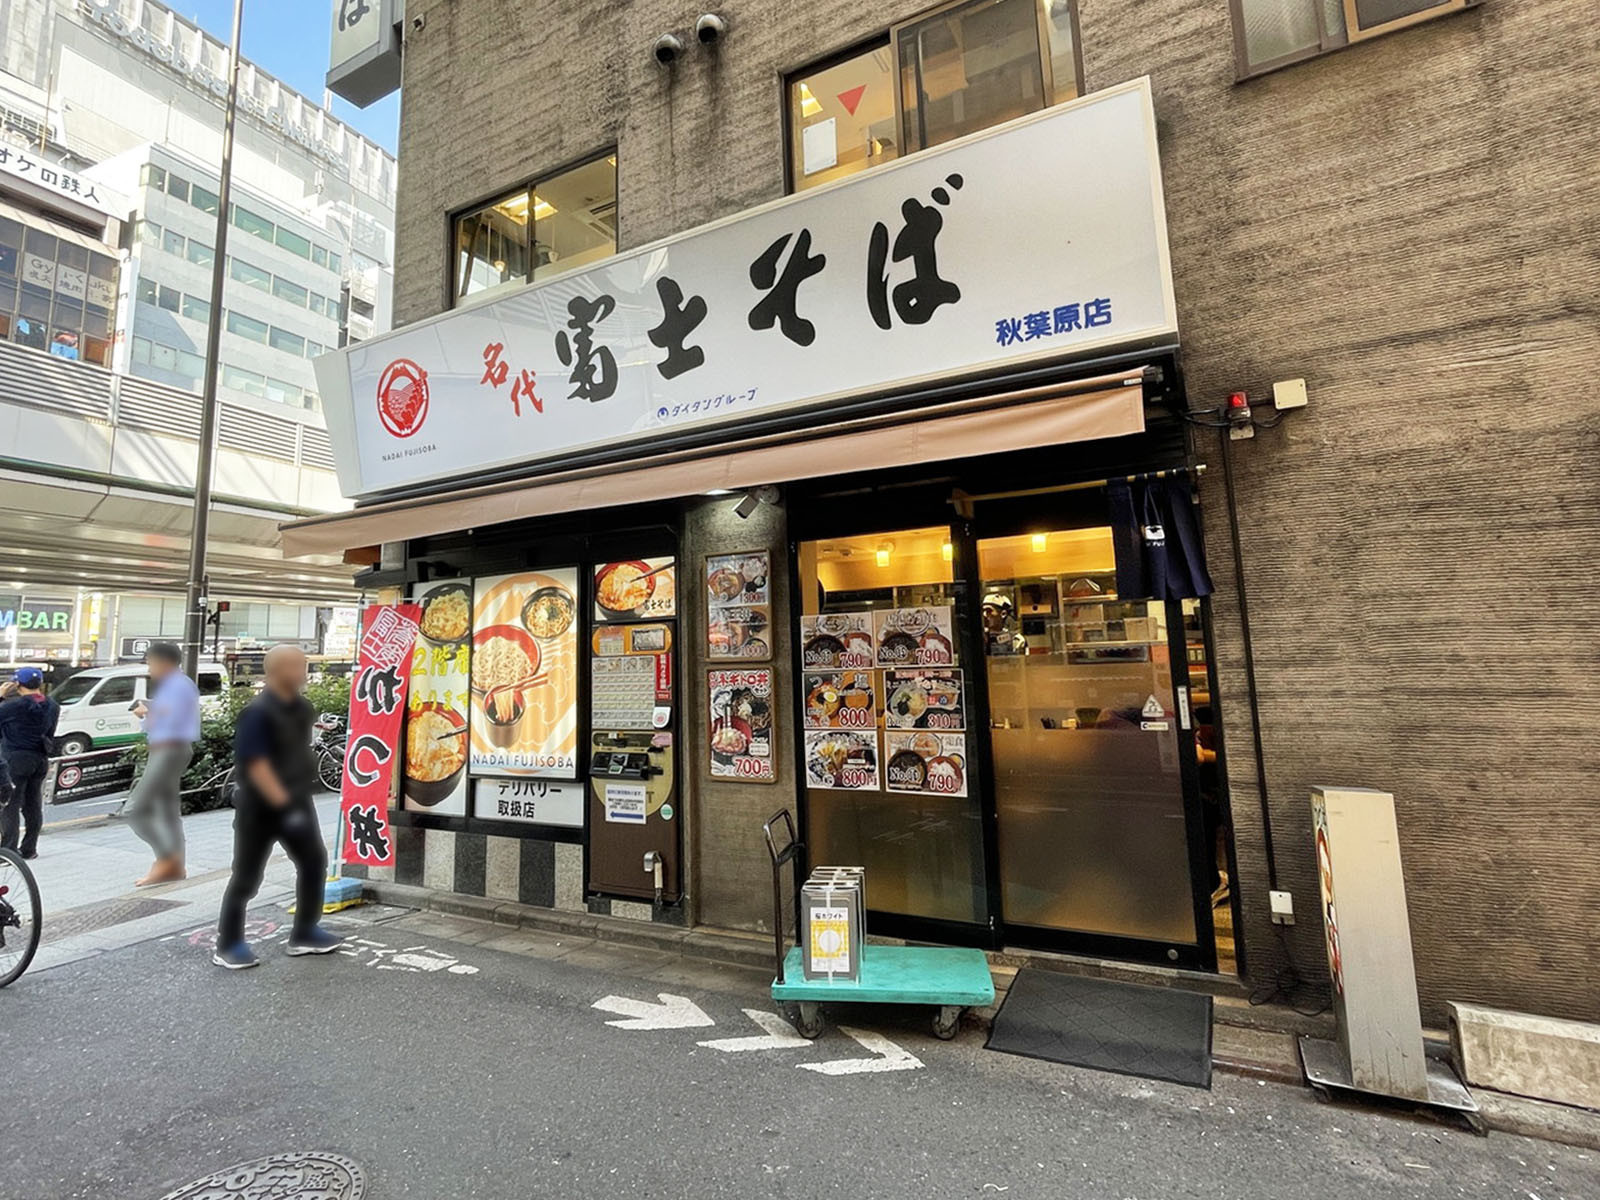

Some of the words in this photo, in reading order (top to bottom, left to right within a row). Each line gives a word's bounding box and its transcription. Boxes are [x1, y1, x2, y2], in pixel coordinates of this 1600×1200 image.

[555, 173, 963, 403] 富士そば
[995, 298, 1112, 347] 秋葉原店
[480, 343, 543, 417] 名代
[672, 387, 758, 416] ダイタングループ
[473, 754, 510, 766] NADAI
[514, 755, 574, 769] FUJISOBA
[499, 781, 562, 797] デリバリー
[498, 800, 535, 818] 取扱店
